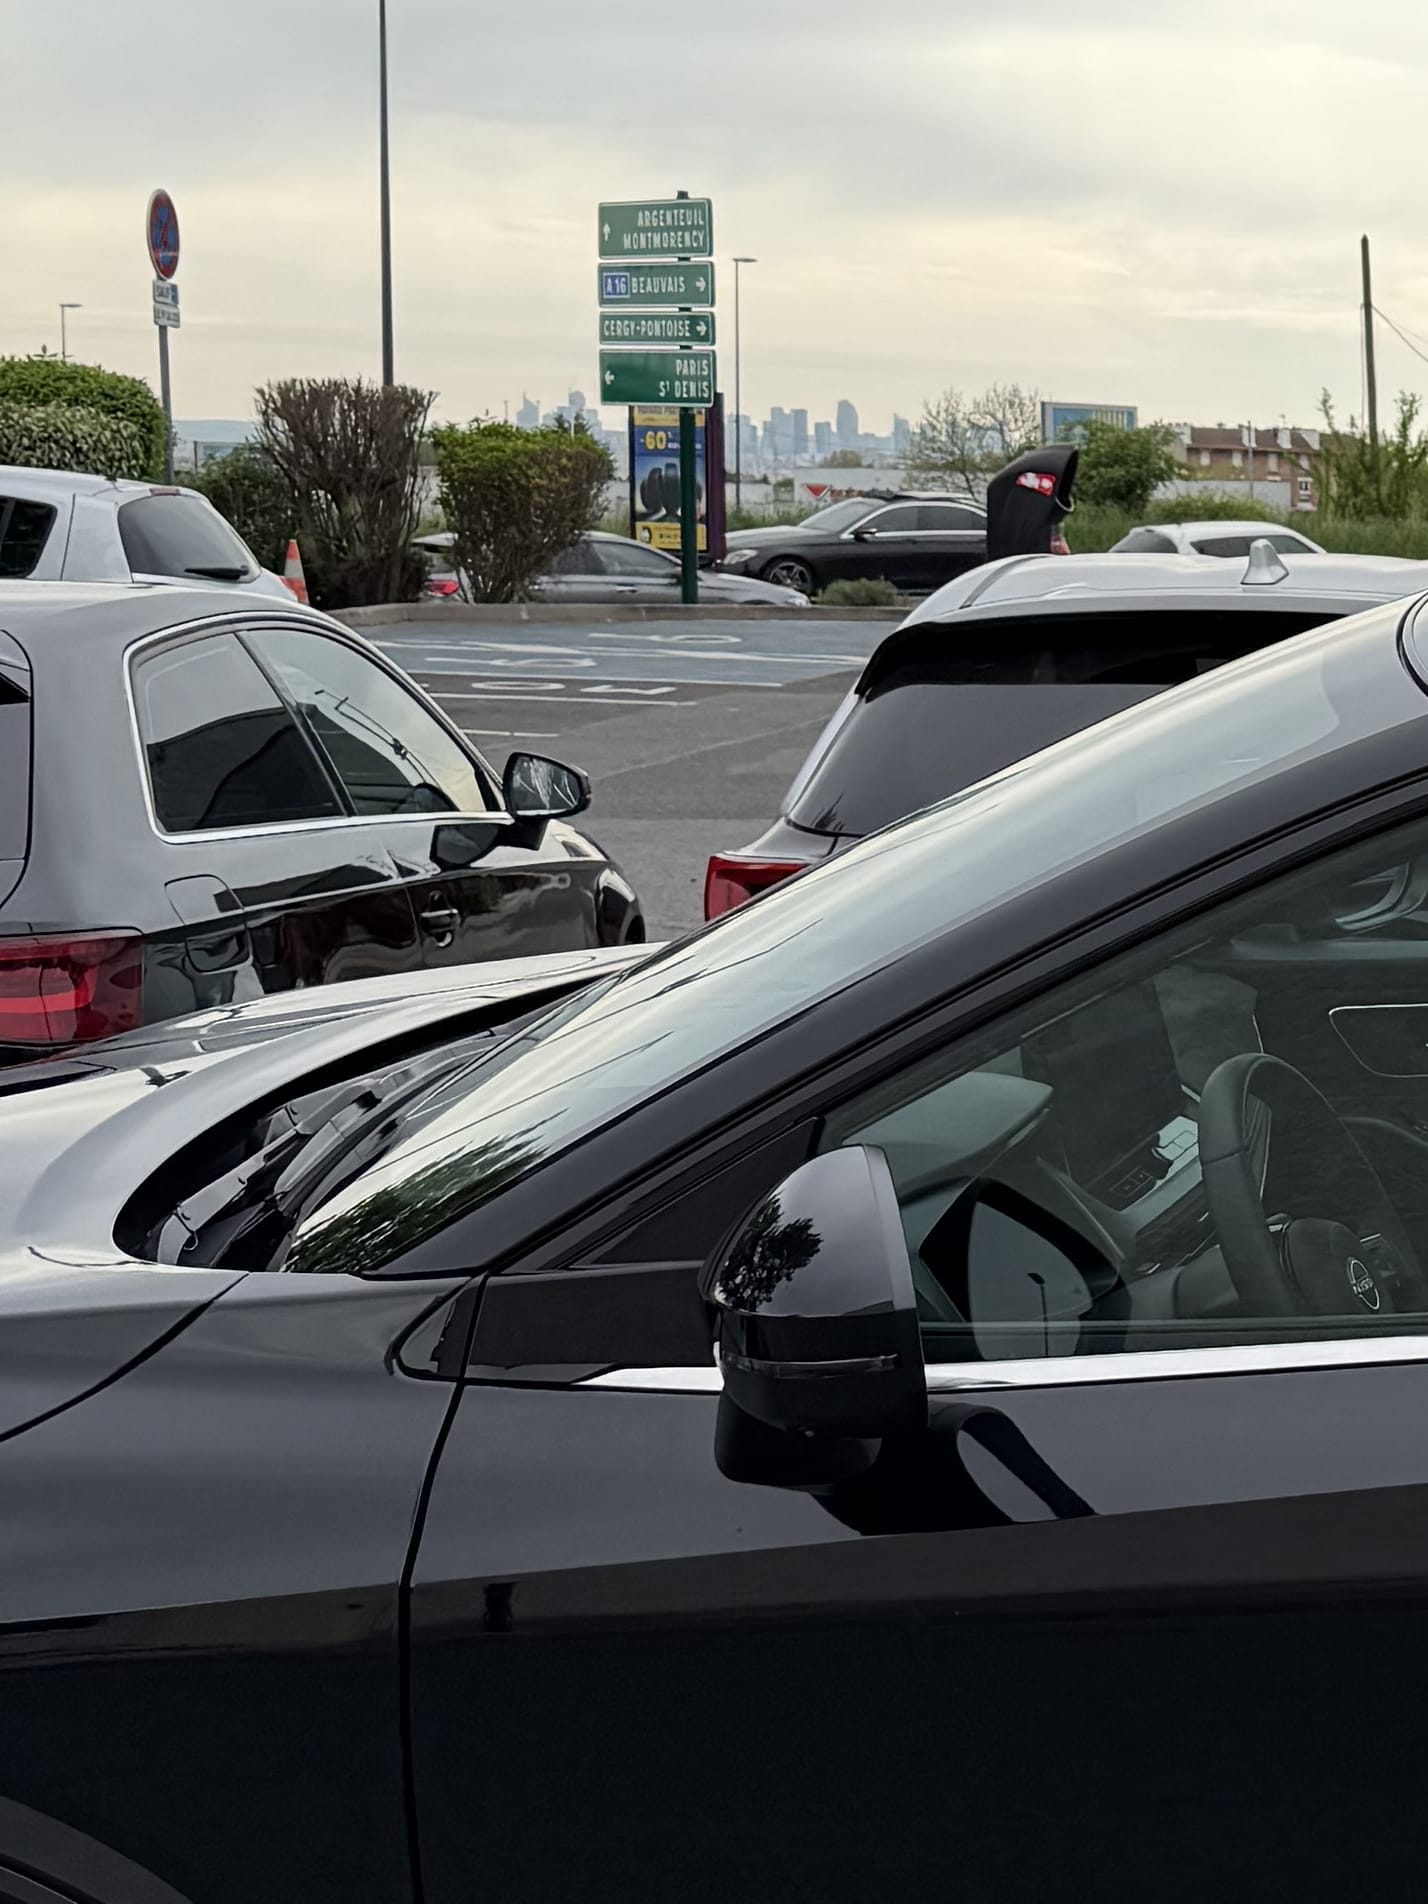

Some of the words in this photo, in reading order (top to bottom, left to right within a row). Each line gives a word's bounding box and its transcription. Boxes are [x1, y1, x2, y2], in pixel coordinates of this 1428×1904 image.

[637, 208, 705, 227] ARGENTEUIL
[623, 230, 705, 249] MONTMORENCY
[631, 276, 686, 294] BEAUVAIS
[603, 319, 691, 337] CERGY-PONTOISE
[676, 359, 709, 376] PARIS
[674, 380, 709, 398] DENIS
